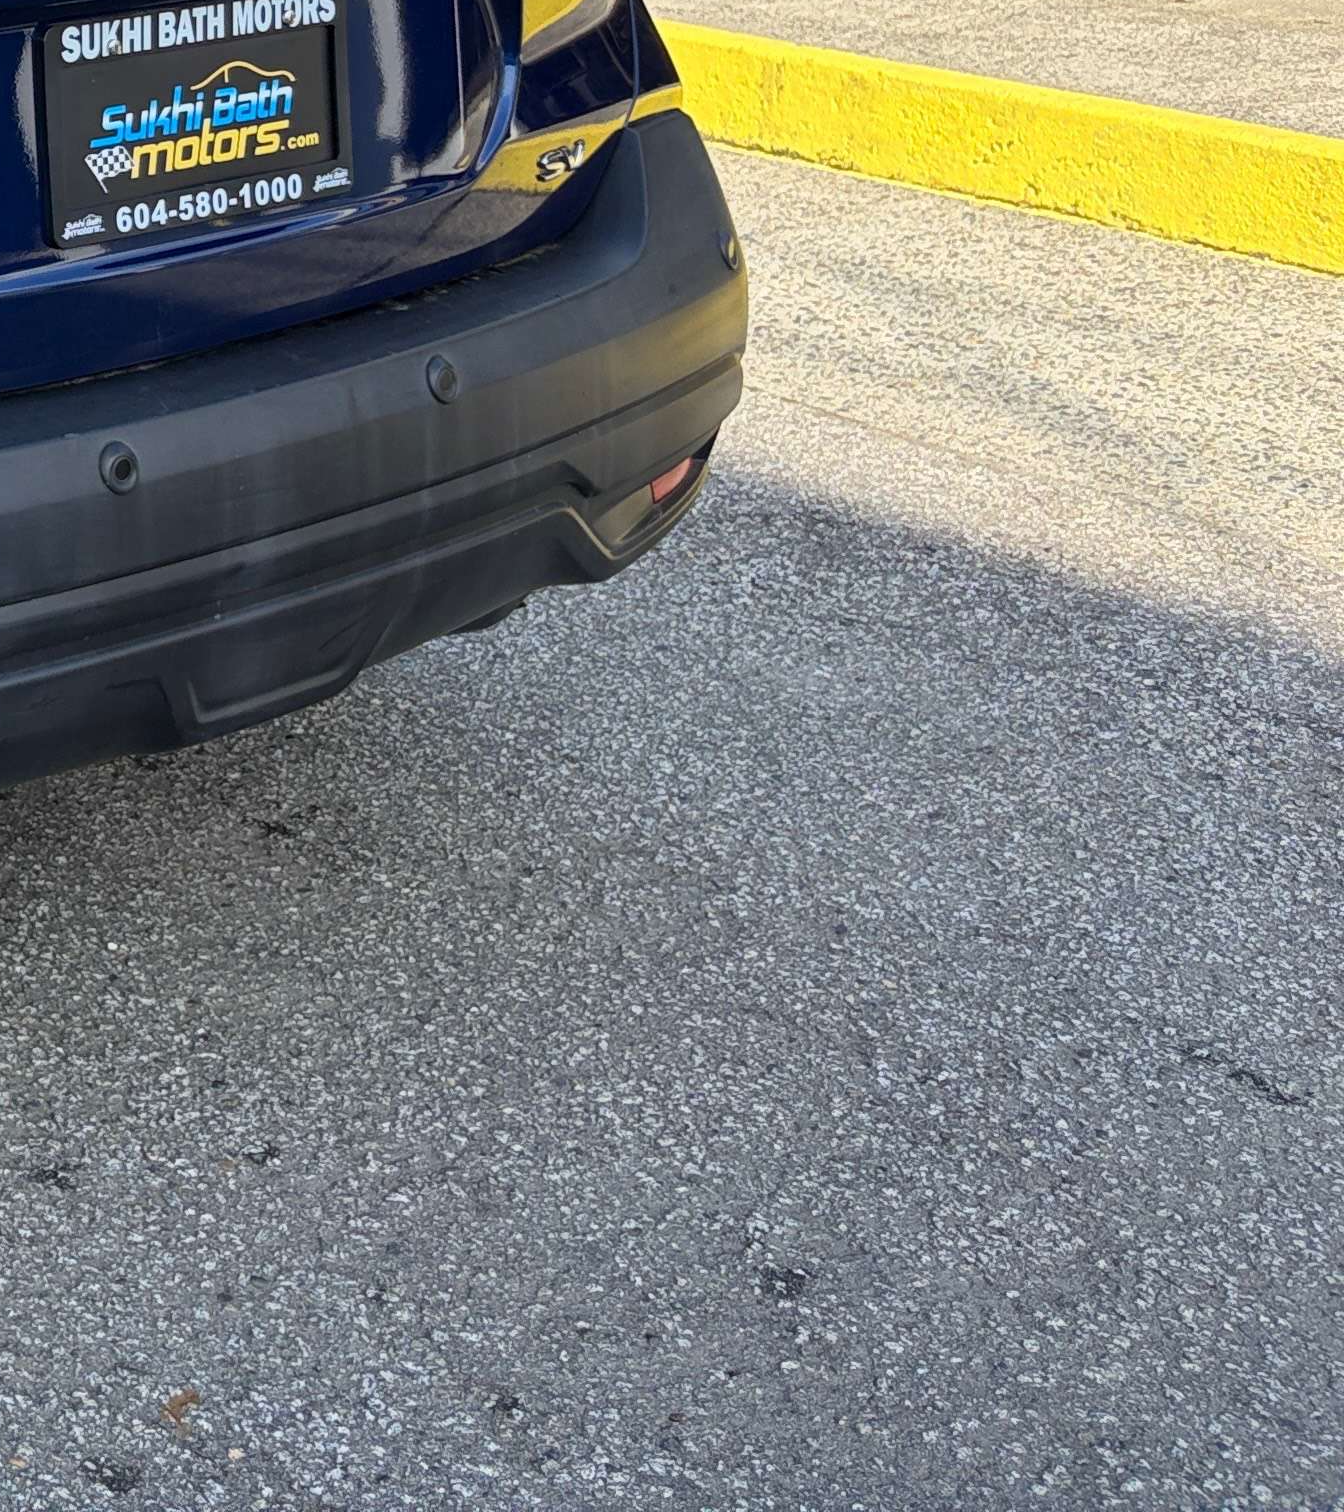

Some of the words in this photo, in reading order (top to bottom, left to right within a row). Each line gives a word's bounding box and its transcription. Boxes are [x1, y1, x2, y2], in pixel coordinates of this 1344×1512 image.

[61, 19, 152, 64] SUKHI
[157, 3, 225, 48] BATH
[90, 85, 205, 149] Sukhi
[212, 79, 294, 128] Bath
[536, 139, 585, 182] SV
[115, 174, 303, 234] 604-580-1000
